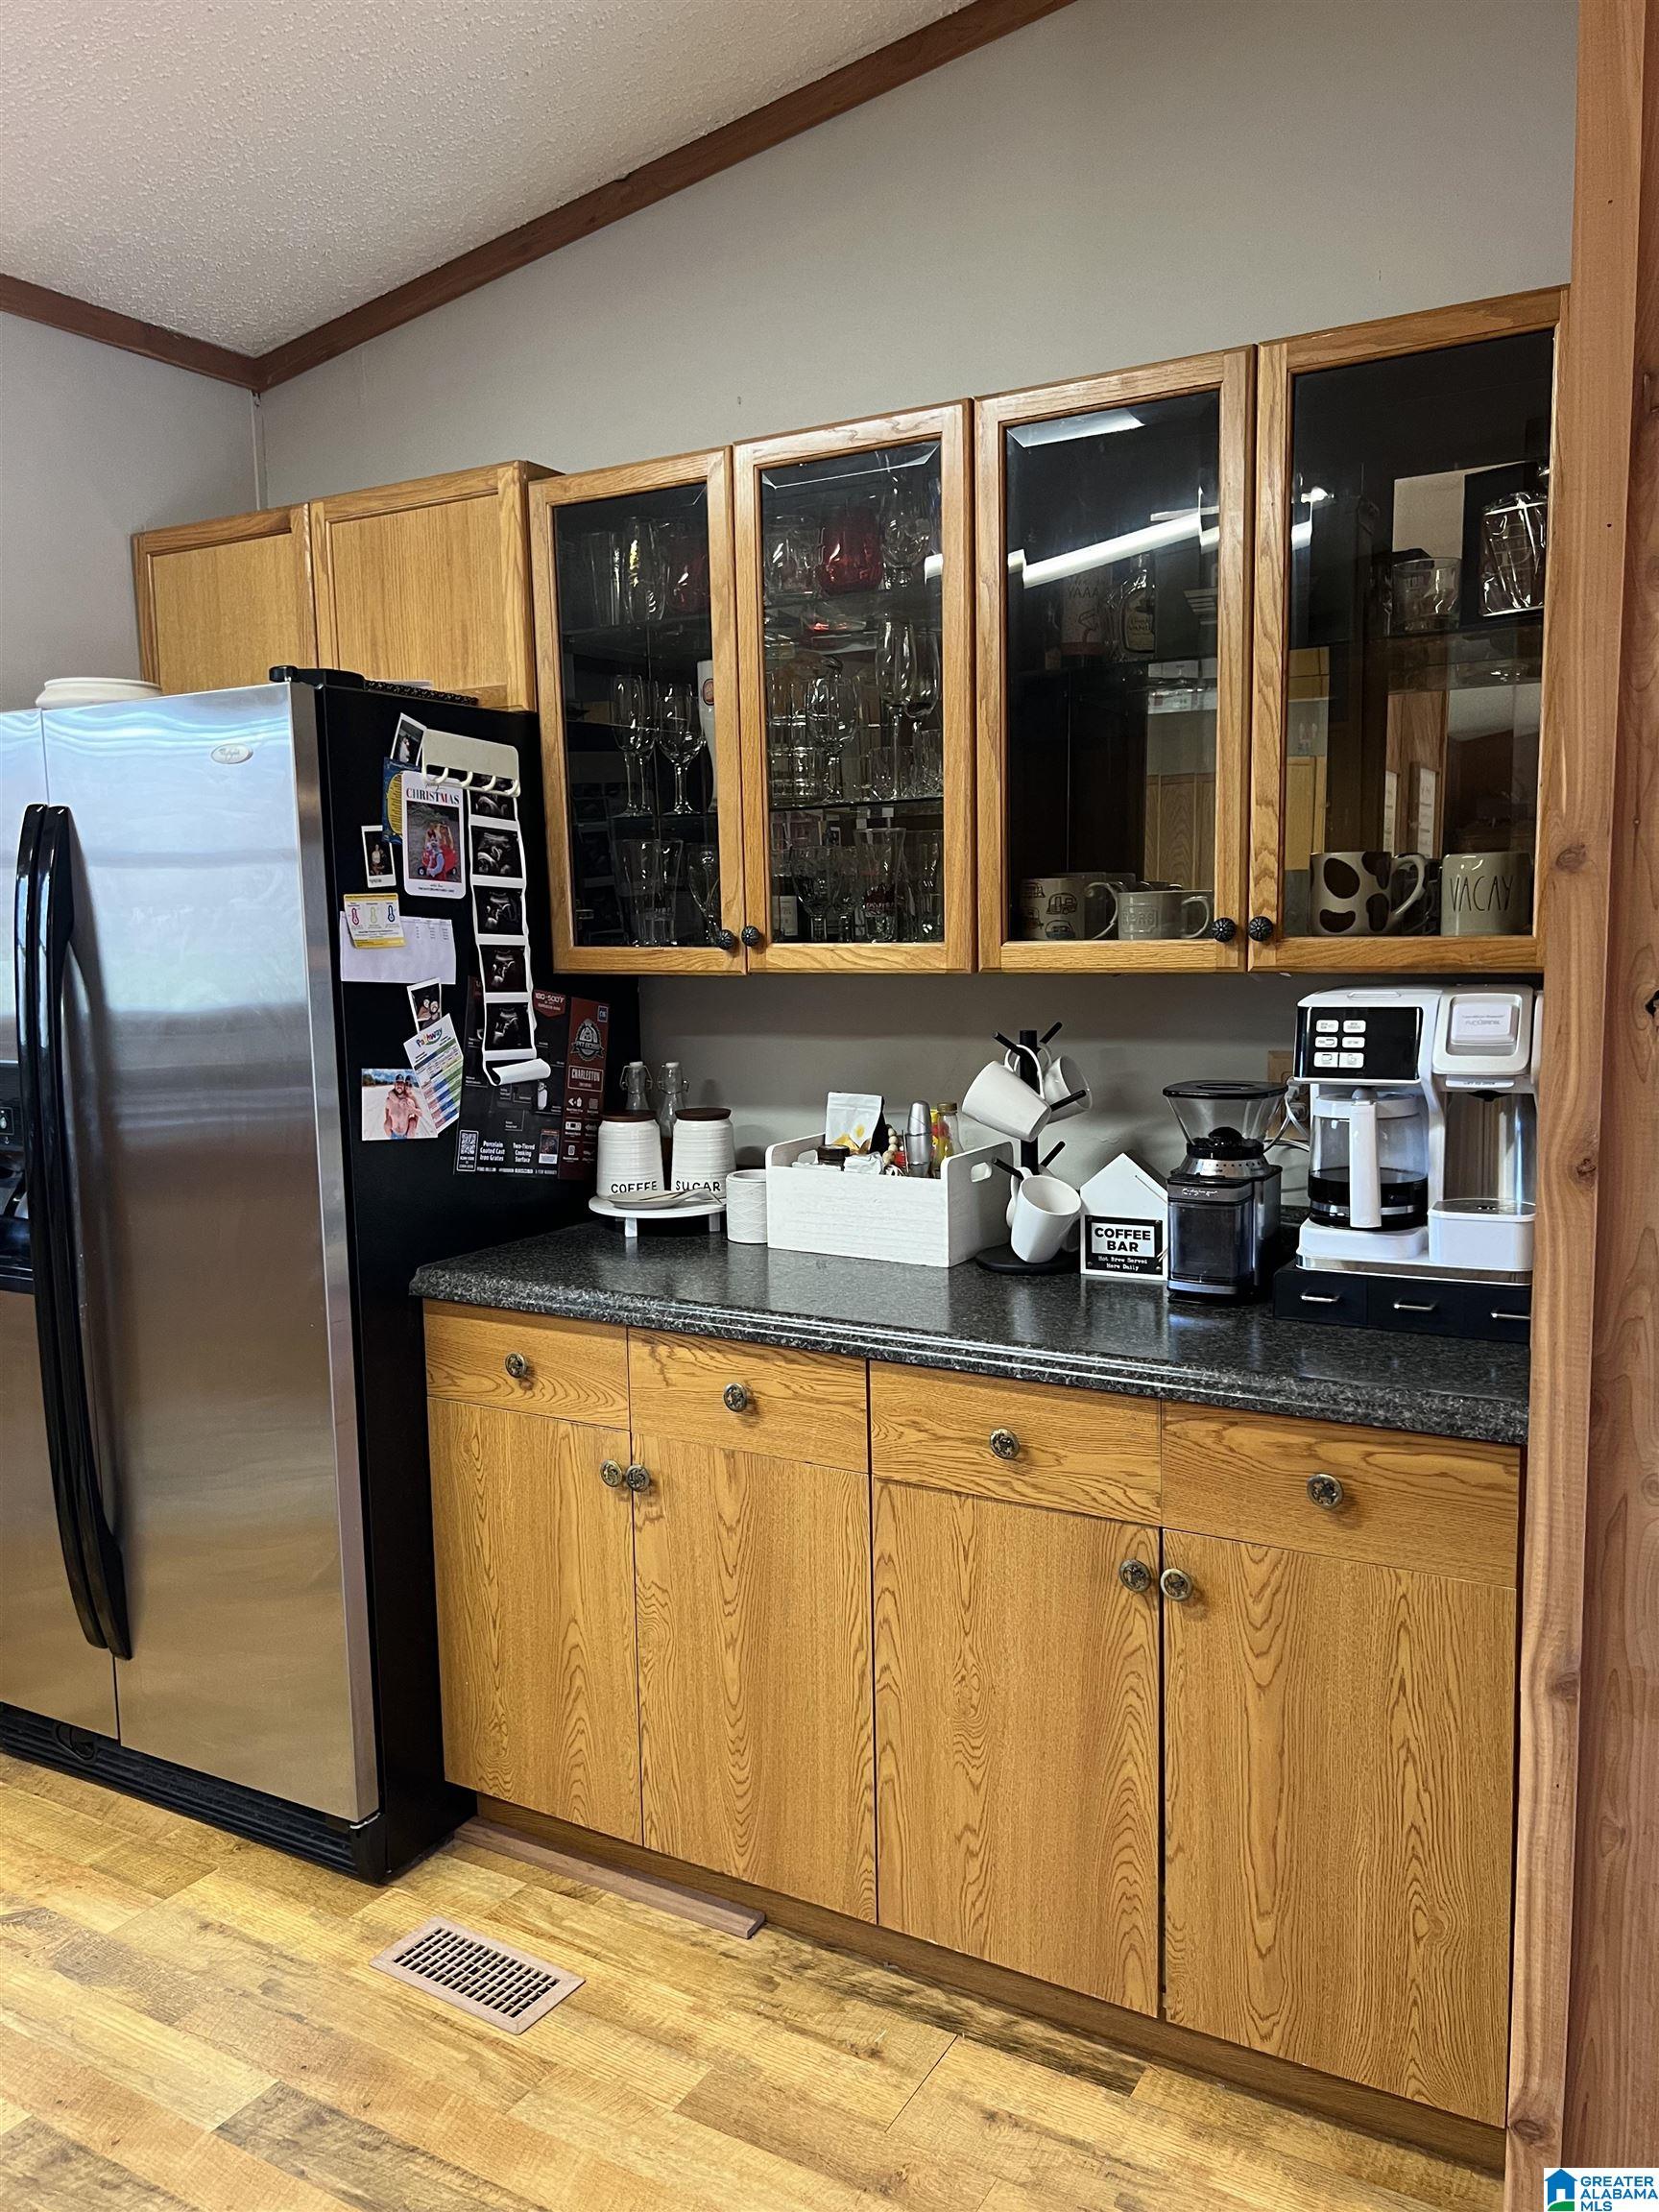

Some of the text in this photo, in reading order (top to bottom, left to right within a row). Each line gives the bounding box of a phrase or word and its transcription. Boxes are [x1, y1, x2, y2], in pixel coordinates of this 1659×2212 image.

[406, 787, 460, 805] CHRISTMAS
[1450, 875, 1514, 911] VACAY
[416, 1027, 443, 1047] Pathway
[1094, 1227, 1151, 1240] COFFEE
[1107, 1240, 1139, 1252] BAR
